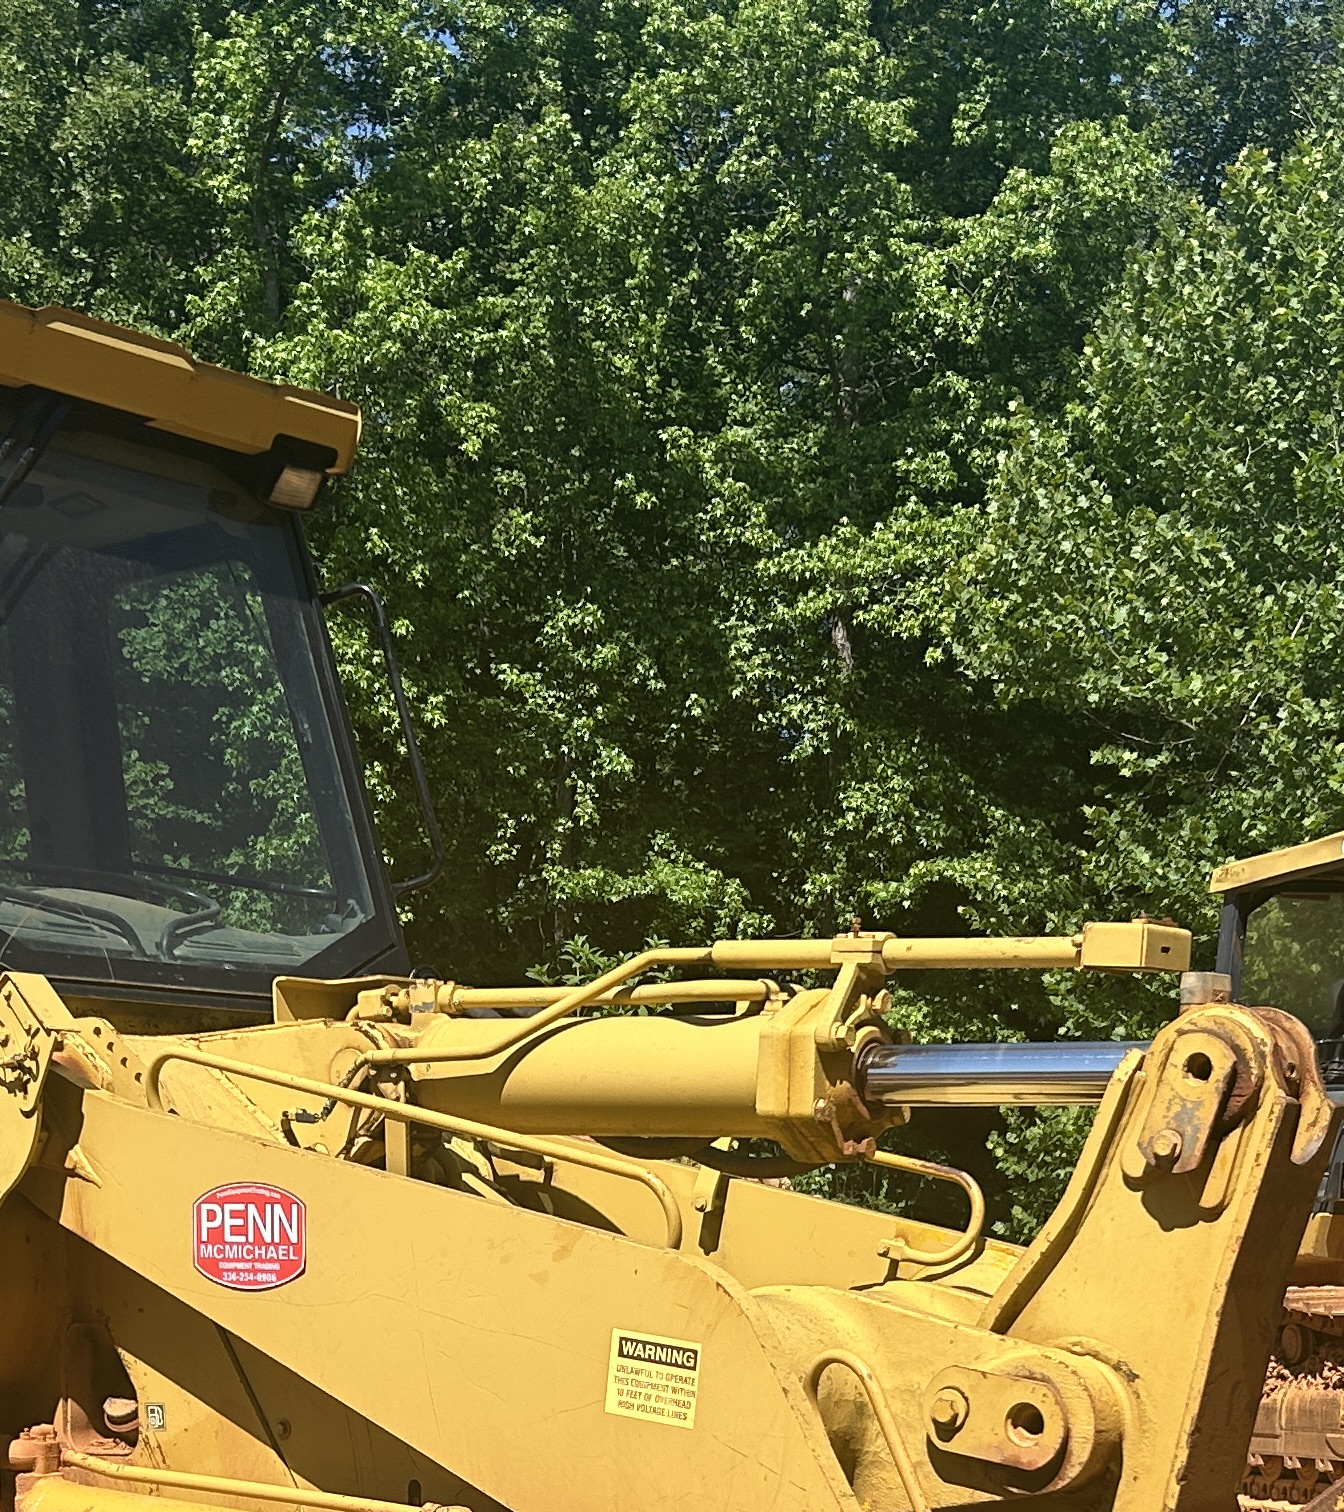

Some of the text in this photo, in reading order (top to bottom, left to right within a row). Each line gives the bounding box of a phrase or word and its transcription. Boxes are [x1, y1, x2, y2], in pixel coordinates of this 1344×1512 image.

[200, 1203, 299, 1244] PENN
[200, 1244, 299, 1260] MCMICHAEL
[218, 1261, 253, 1270] EQUIPMENT
[621, 1340, 695, 1367] WARNING
[616, 1364, 696, 1386] UNLAWFUL TO OPERATE
[613, 1375, 697, 1398] THIS EQUIPMENT WITHIN
[626, 1389, 642, 1400] FEET
[644, 1393, 653, 1402] OF
[654, 1394, 692, 1409] OVERHEAD
[636, 1403, 666, 1416] VOLTAGE
[667, 1409, 688, 1421] LINES
